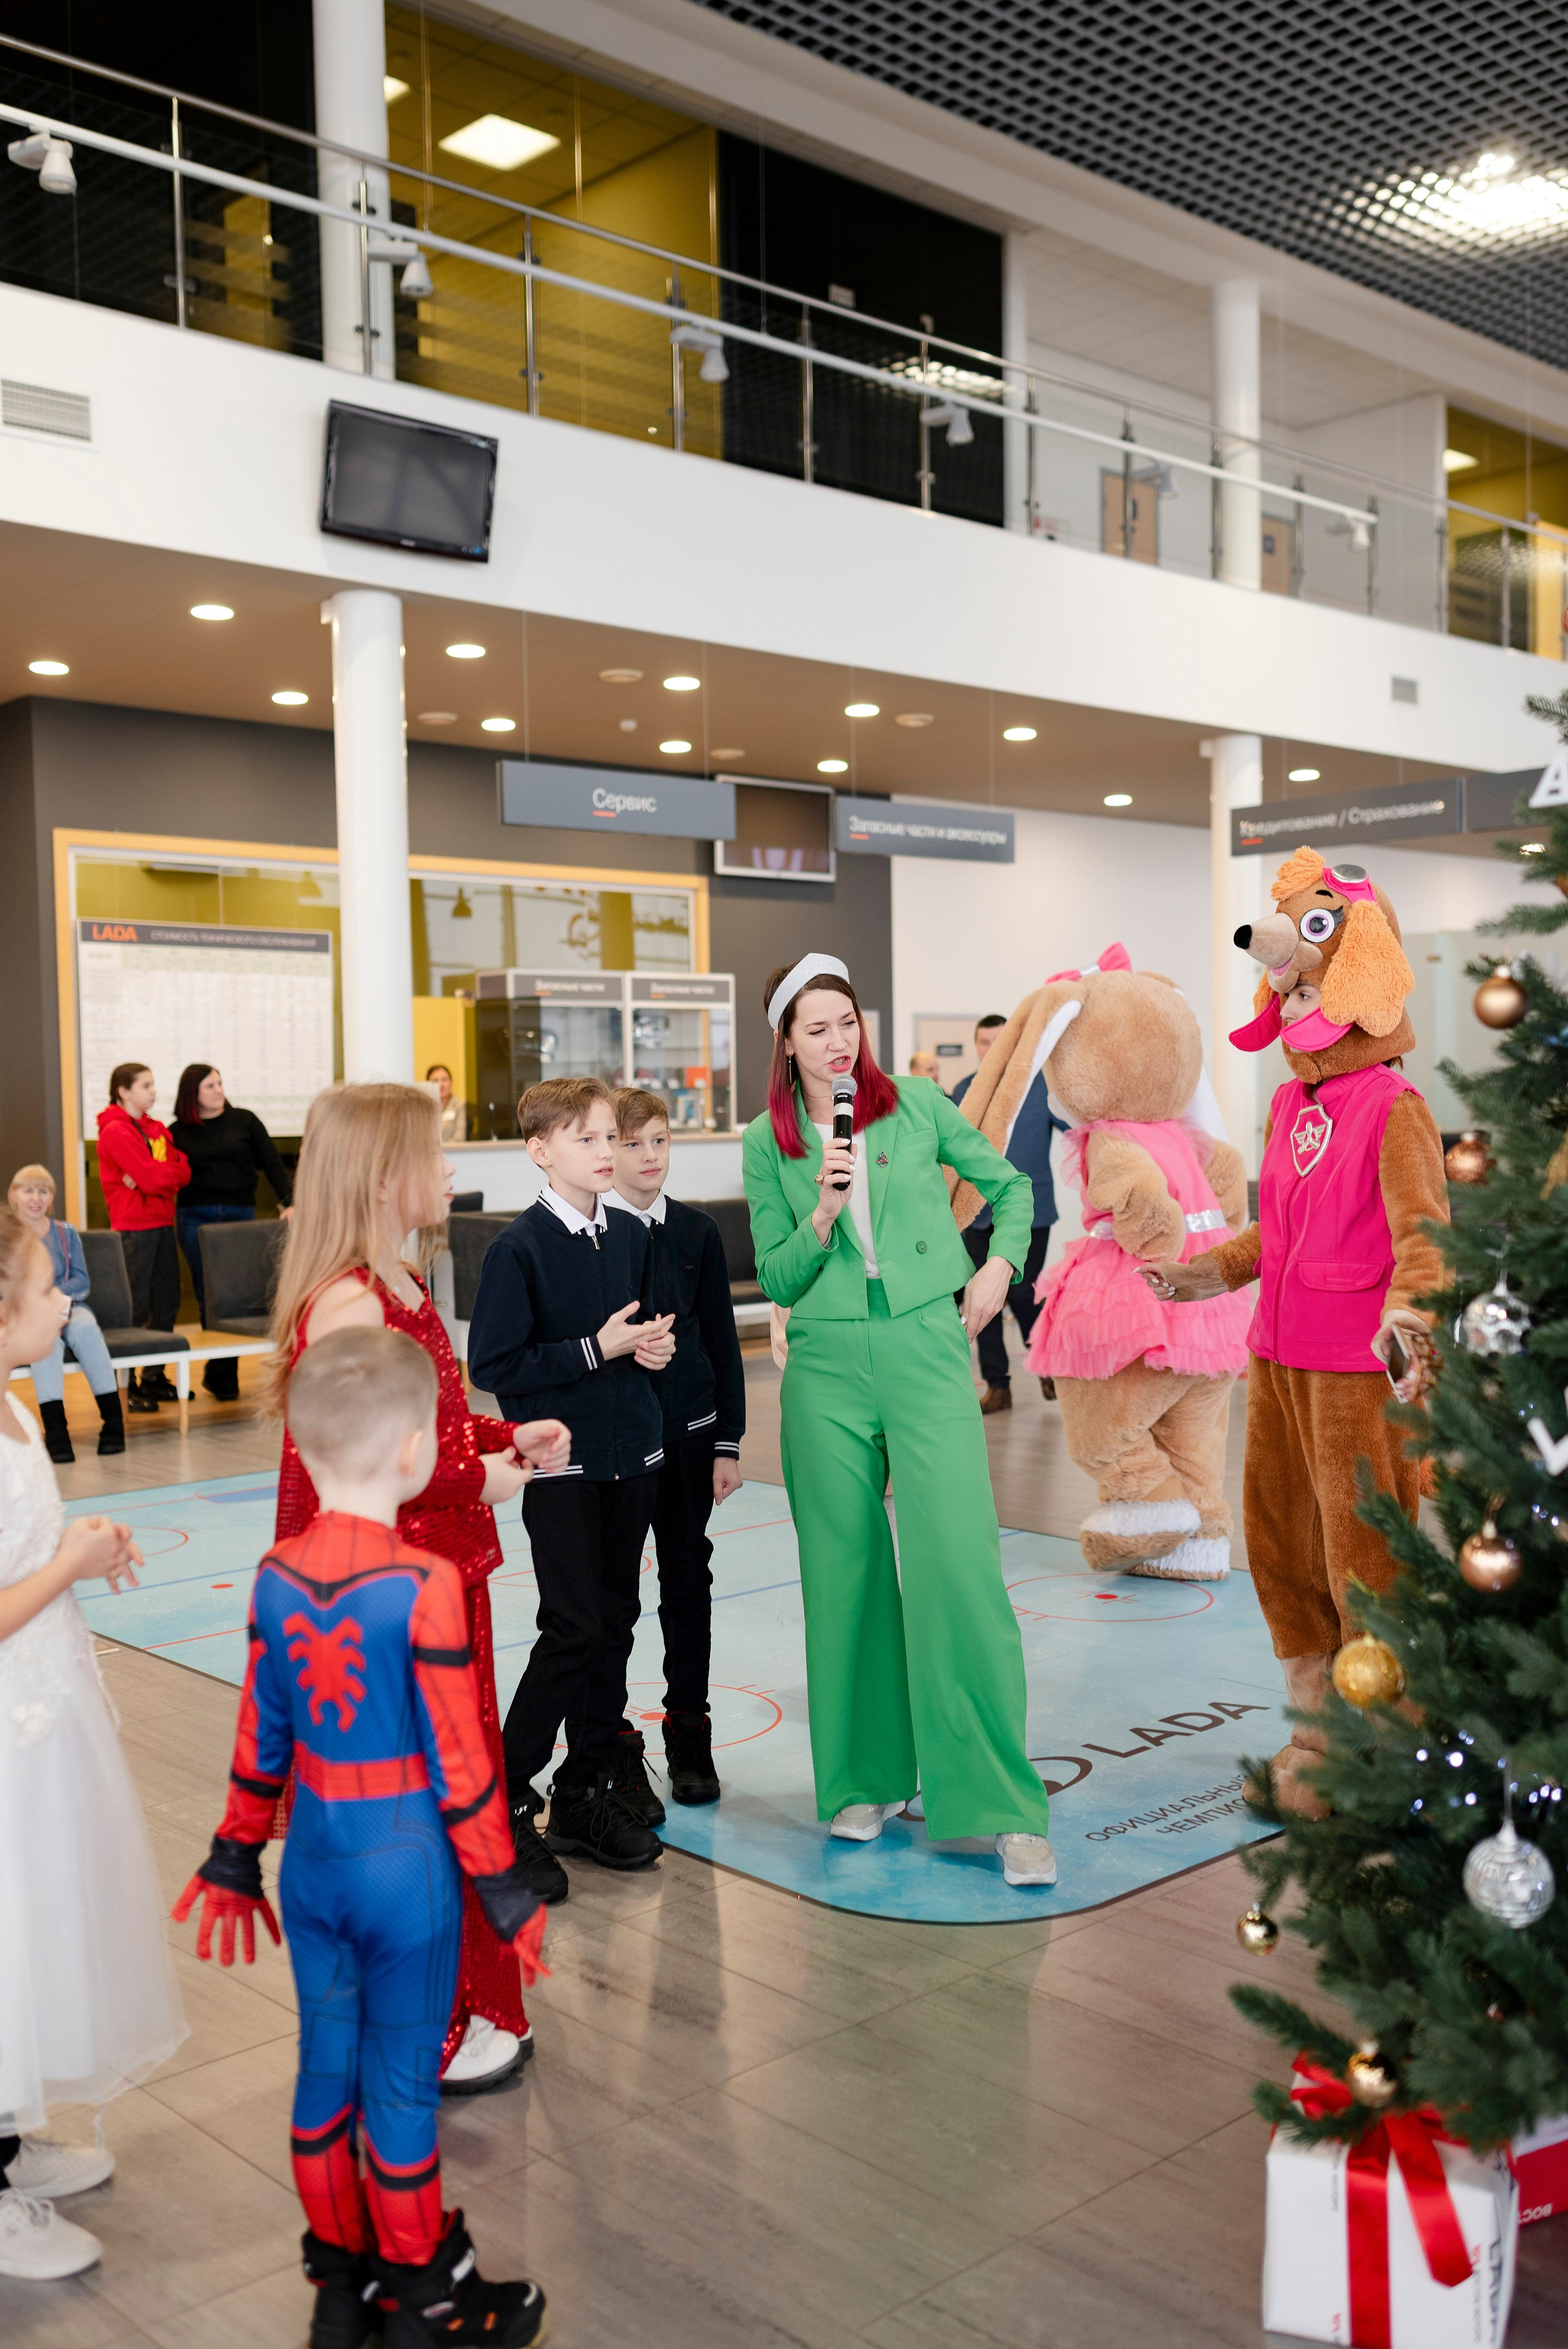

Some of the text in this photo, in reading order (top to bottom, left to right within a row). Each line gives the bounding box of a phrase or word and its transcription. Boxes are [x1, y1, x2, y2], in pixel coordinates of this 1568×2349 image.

[592, 787, 657, 813] Сервис
[849, 815, 906, 836] Запасные
[906, 823, 936, 838] части
[1239, 813, 1338, 837] Кредитование
[1348, 800, 1445, 824] Страхование
[92, 924, 138, 942] LADA
[1080, 1702, 1272, 1759] LADA
[1519, 2203, 1553, 2224] ВОС
